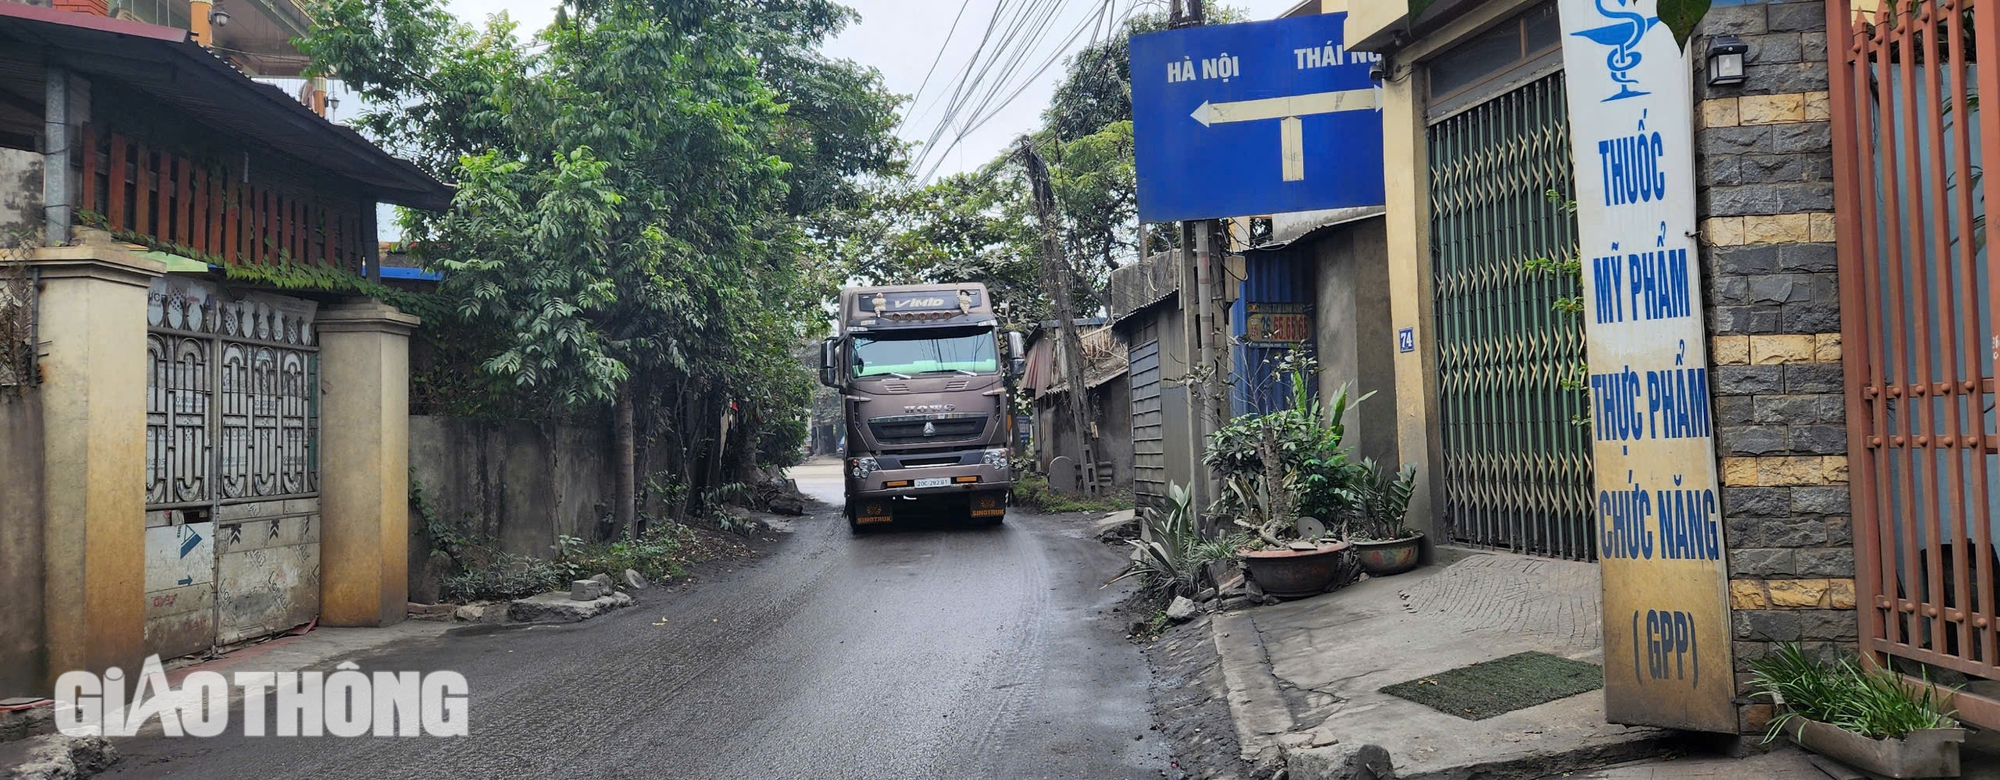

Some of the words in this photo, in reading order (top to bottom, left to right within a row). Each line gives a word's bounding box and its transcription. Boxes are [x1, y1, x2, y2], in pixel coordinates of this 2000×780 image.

[1167, 55, 1196, 83] HÀ
[1202, 52, 1240, 83] NỘI
[1294, 40, 1344, 70] THÁI
[1598, 108, 1665, 206] THUỐC
[1593, 242, 1623, 324] MỸ
[1628, 221, 1691, 321] PHẨM
[1400, 332, 1413, 348] 74
[1591, 365, 1643, 456] THỰC
[1647, 339, 1710, 439] PHẨM
[1600, 469, 1653, 559] CHỨC
[1657, 474, 1719, 560] NĂNG
